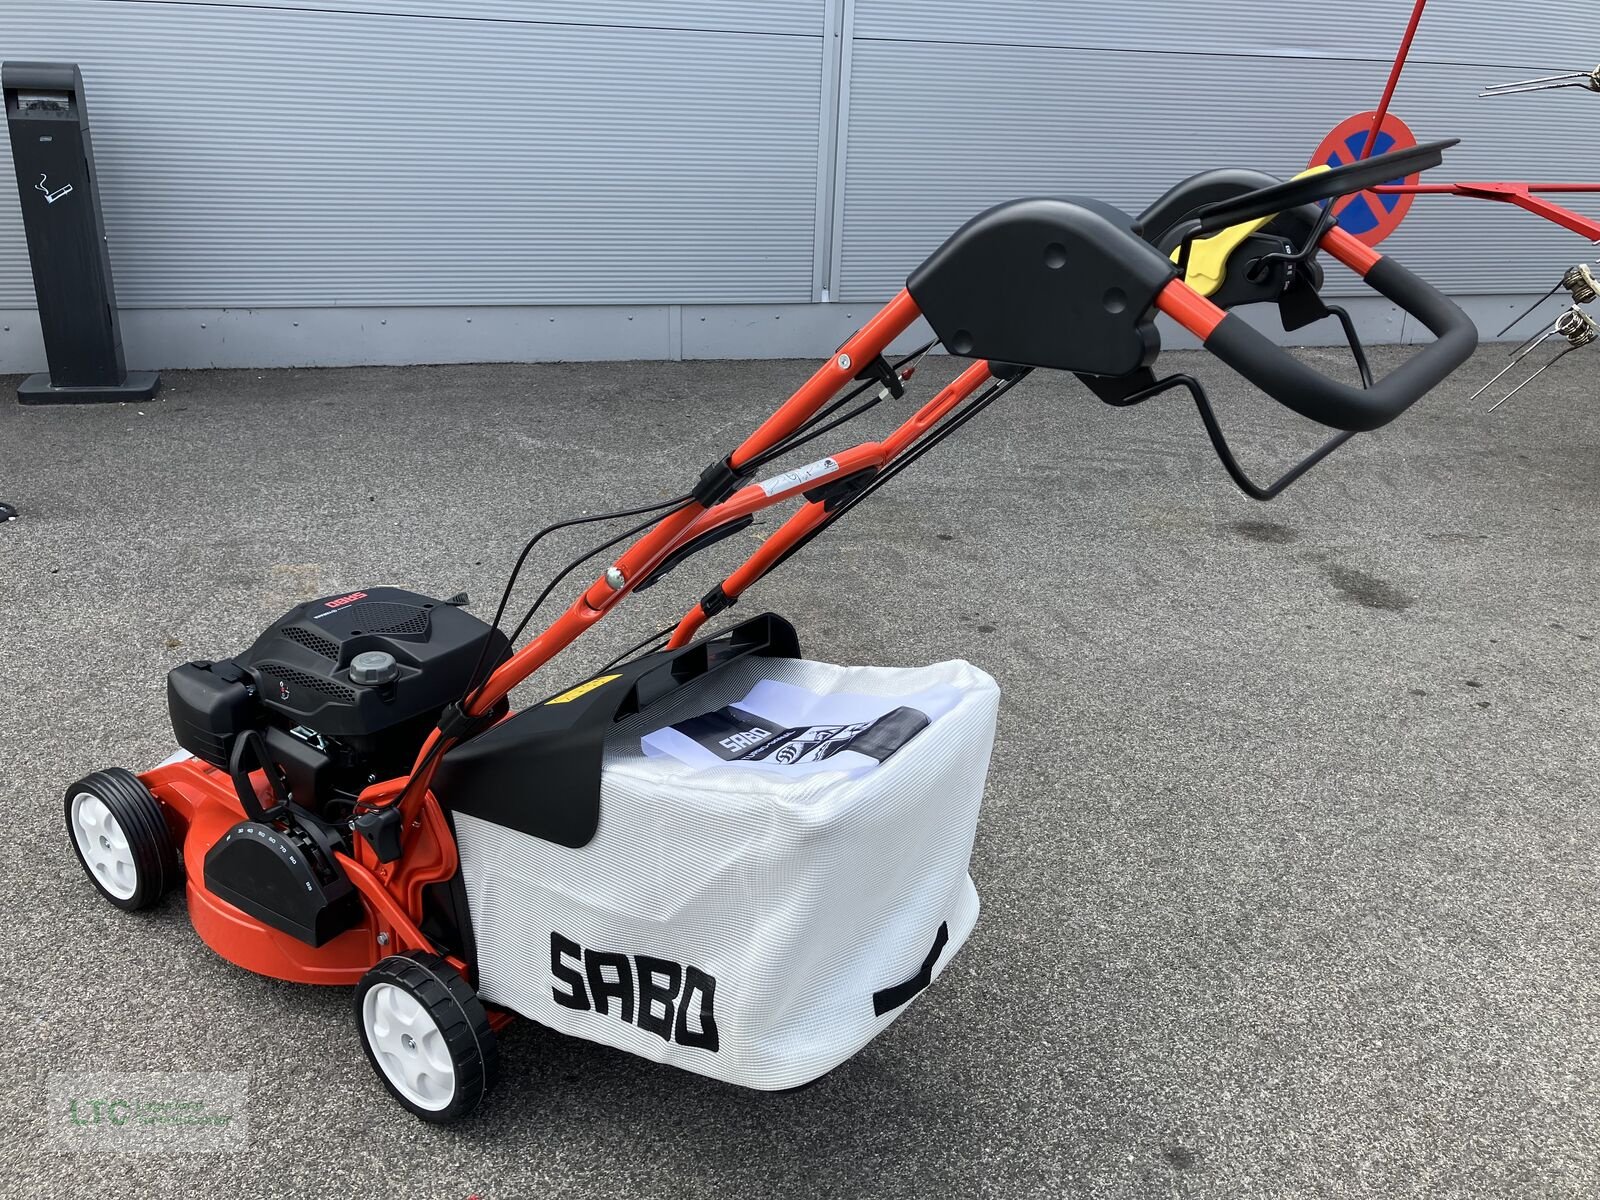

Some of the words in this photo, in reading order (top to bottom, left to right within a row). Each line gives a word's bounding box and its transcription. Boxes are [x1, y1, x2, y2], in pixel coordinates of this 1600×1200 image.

[324, 591, 368, 608] SABO
[718, 727, 772, 753] SABO
[280, 844, 287, 853] 70
[550, 930, 719, 1053] SABO
